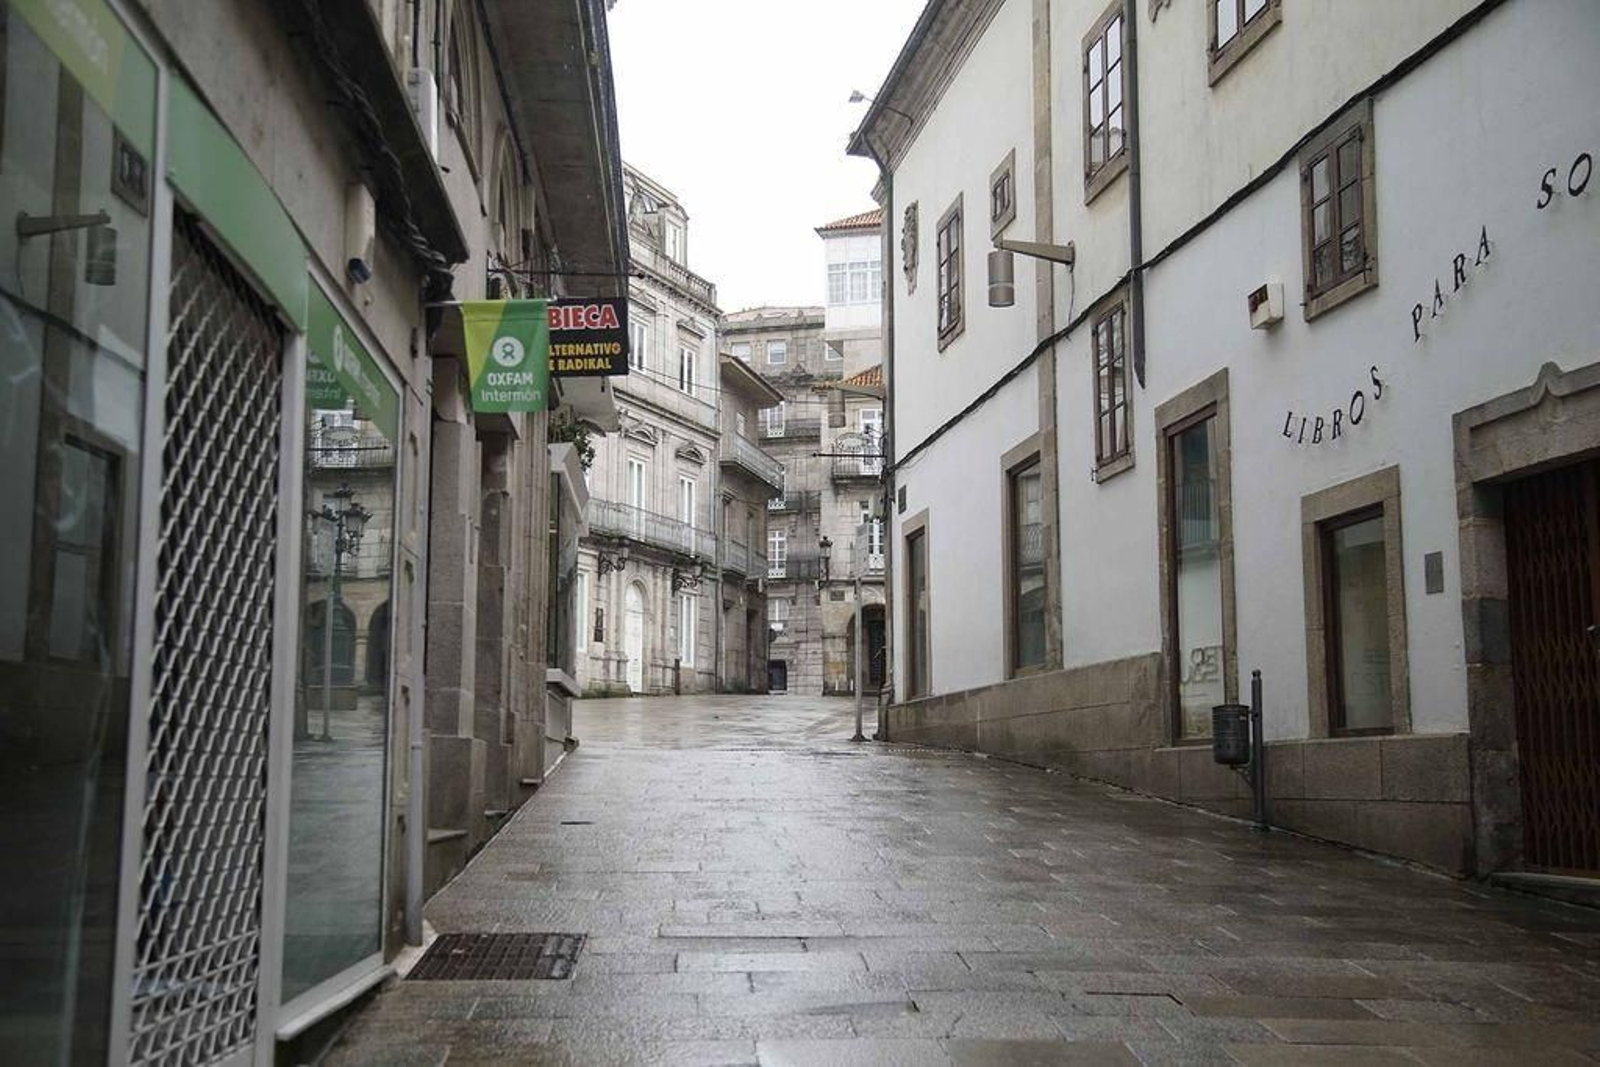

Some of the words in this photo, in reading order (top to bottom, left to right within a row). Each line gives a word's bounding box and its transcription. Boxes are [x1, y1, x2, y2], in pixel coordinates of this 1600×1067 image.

[1283, 365, 1382, 444] LIBROS
[1411, 224, 1490, 342] PARA
[1537, 153, 1592, 209] SO
[558, 357, 612, 371] RADIKAL
[487, 372, 534, 386] OXFAM
[481, 387, 541, 402] Intermón
